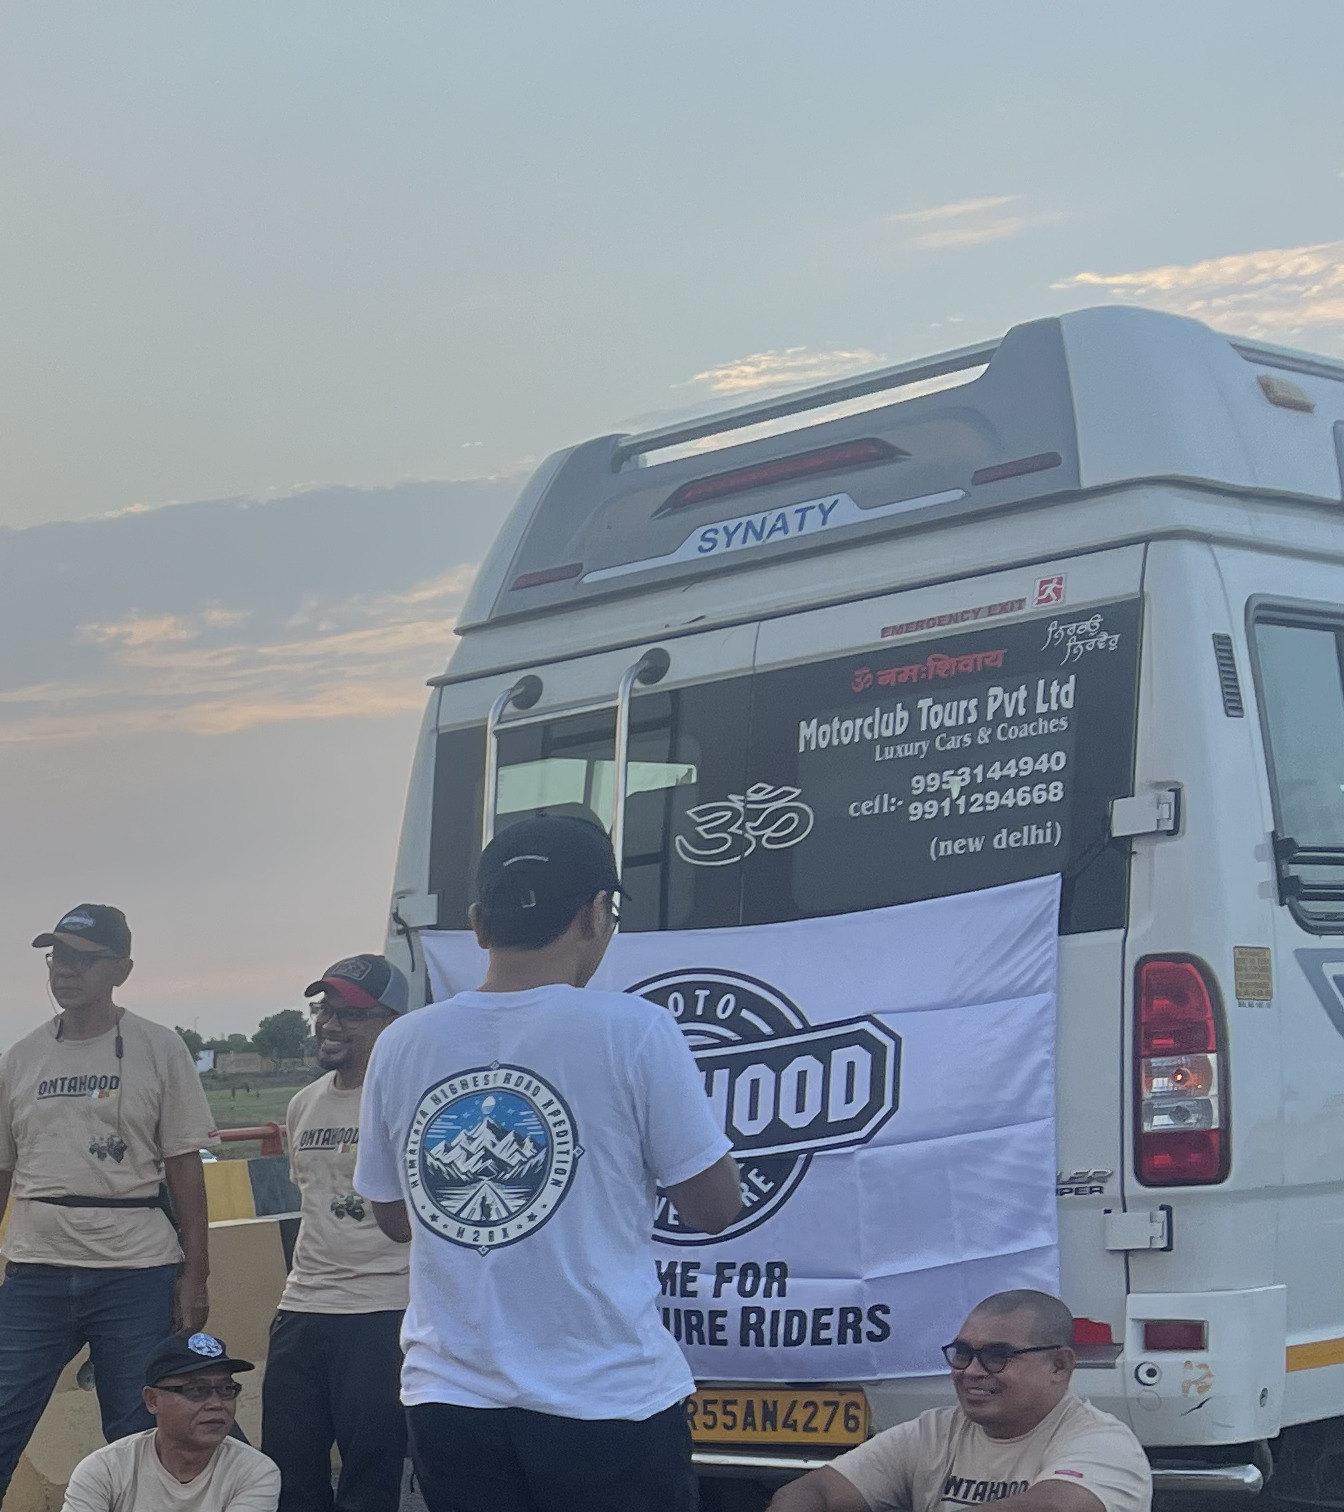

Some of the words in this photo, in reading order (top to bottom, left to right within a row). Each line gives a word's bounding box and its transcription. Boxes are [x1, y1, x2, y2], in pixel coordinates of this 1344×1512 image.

[697, 499, 839, 553] SYNATY
[880, 607, 981, 639] EMERGENCY
[987, 597, 1027, 617] EXIT
[798, 702, 910, 753] Motorclub
[917, 697, 978, 731] Tours
[986, 684, 1027, 722] Pvt
[1035, 674, 1076, 715] Ltd
[874, 738, 930, 762] Luxury
[934, 731, 972, 752] Cars
[976, 726, 991, 745] &
[996, 714, 1069, 741] Coaches
[911, 750, 1067, 796] 9953144940
[908, 781, 1064, 822] 9911294668
[929, 834, 986, 862] (new
[992, 821, 1062, 850] delhi)
[667, 989, 736, 1019] OTO
[37, 1074, 121, 1097] ONTAHOOD
[700, 1044, 872, 1137] HOOD
[408, 1109, 429, 1189] HIMALAYA
[430, 1072, 498, 1106] HIGHEST
[502, 1072, 542, 1098] ROAD
[541, 1098, 571, 1188] XPEDITION
[655, 1260, 701, 1298] ME
[712, 1260, 789, 1299] FOR
[739, 1303, 892, 1348] RIDERS
[685, 1398, 862, 1433] R55AN4276
